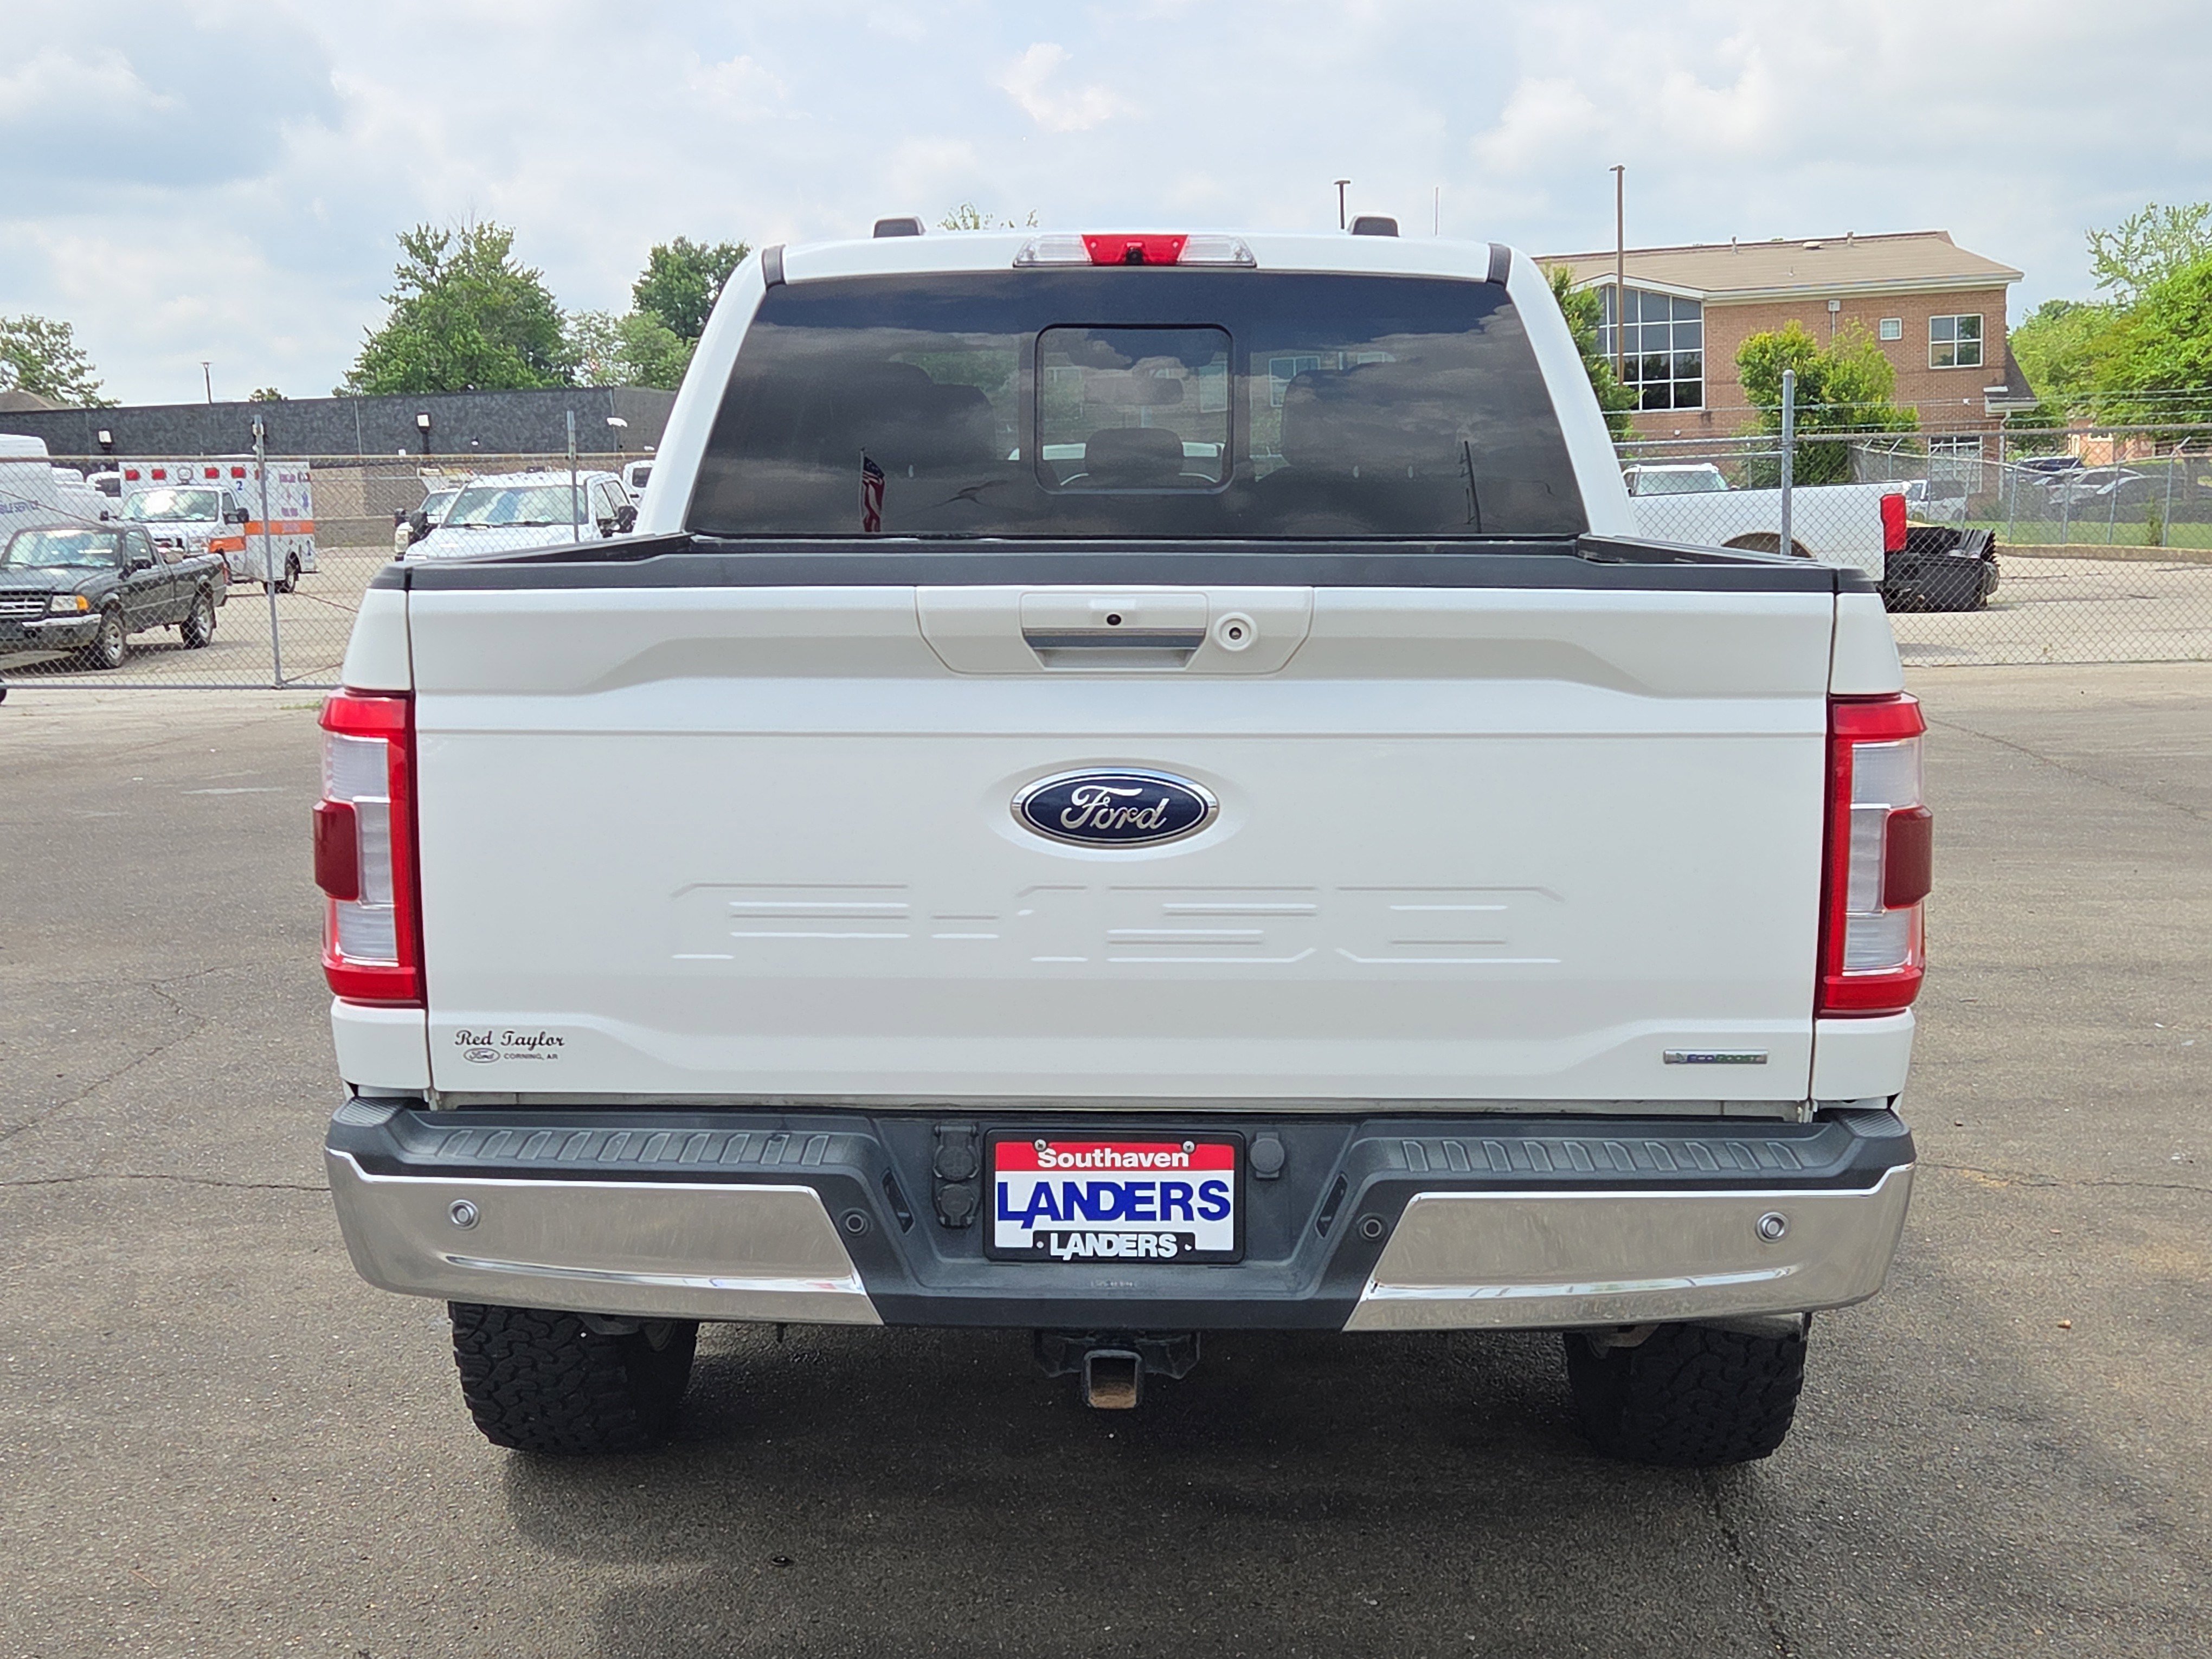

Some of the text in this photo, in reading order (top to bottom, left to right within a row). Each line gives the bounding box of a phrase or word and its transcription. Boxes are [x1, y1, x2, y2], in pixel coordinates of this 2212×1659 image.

[236, 480, 243, 491] 2
[1060, 785, 1170, 829] Ford
[455, 1030, 565, 1051] Red Taylor
[1037, 1148, 1190, 1168] Southaven
[997, 1180, 1231, 1229] LANDERS
[1050, 1233, 1178, 1261] LANDERS
